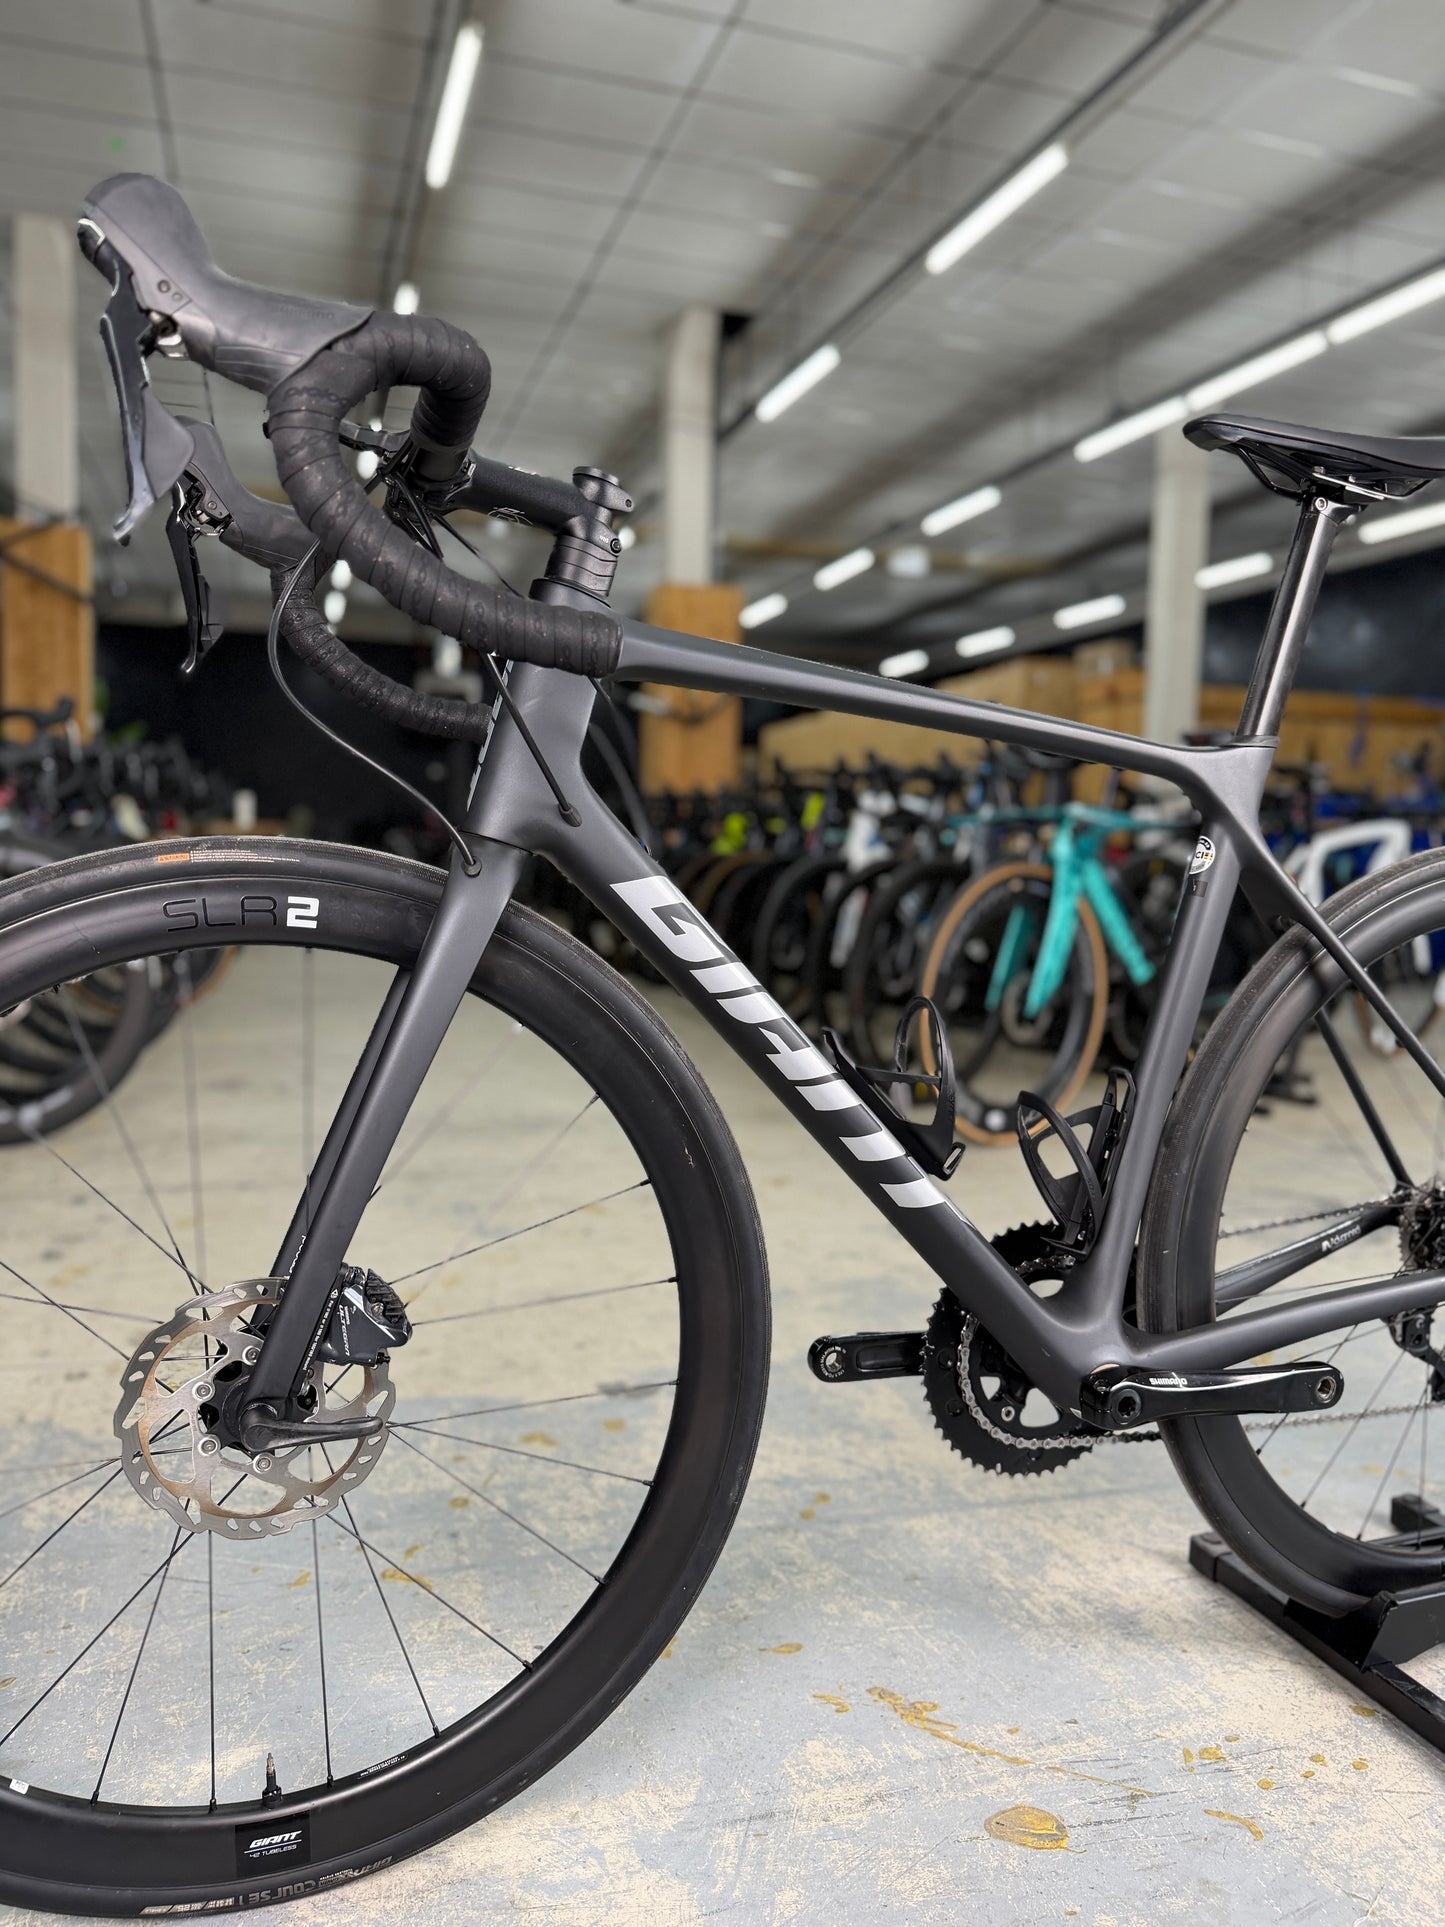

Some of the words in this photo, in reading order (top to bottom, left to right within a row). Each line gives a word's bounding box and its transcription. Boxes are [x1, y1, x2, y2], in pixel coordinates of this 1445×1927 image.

[162, 896, 277, 932] SLR
[286, 896, 320, 929] 2
[609, 875, 974, 1228] GIANT
[1149, 1377, 1188, 1386] SHIMANO
[249, 1830, 302, 1849] GIANT
[262, 1844, 297, 1856] TUBELESS
